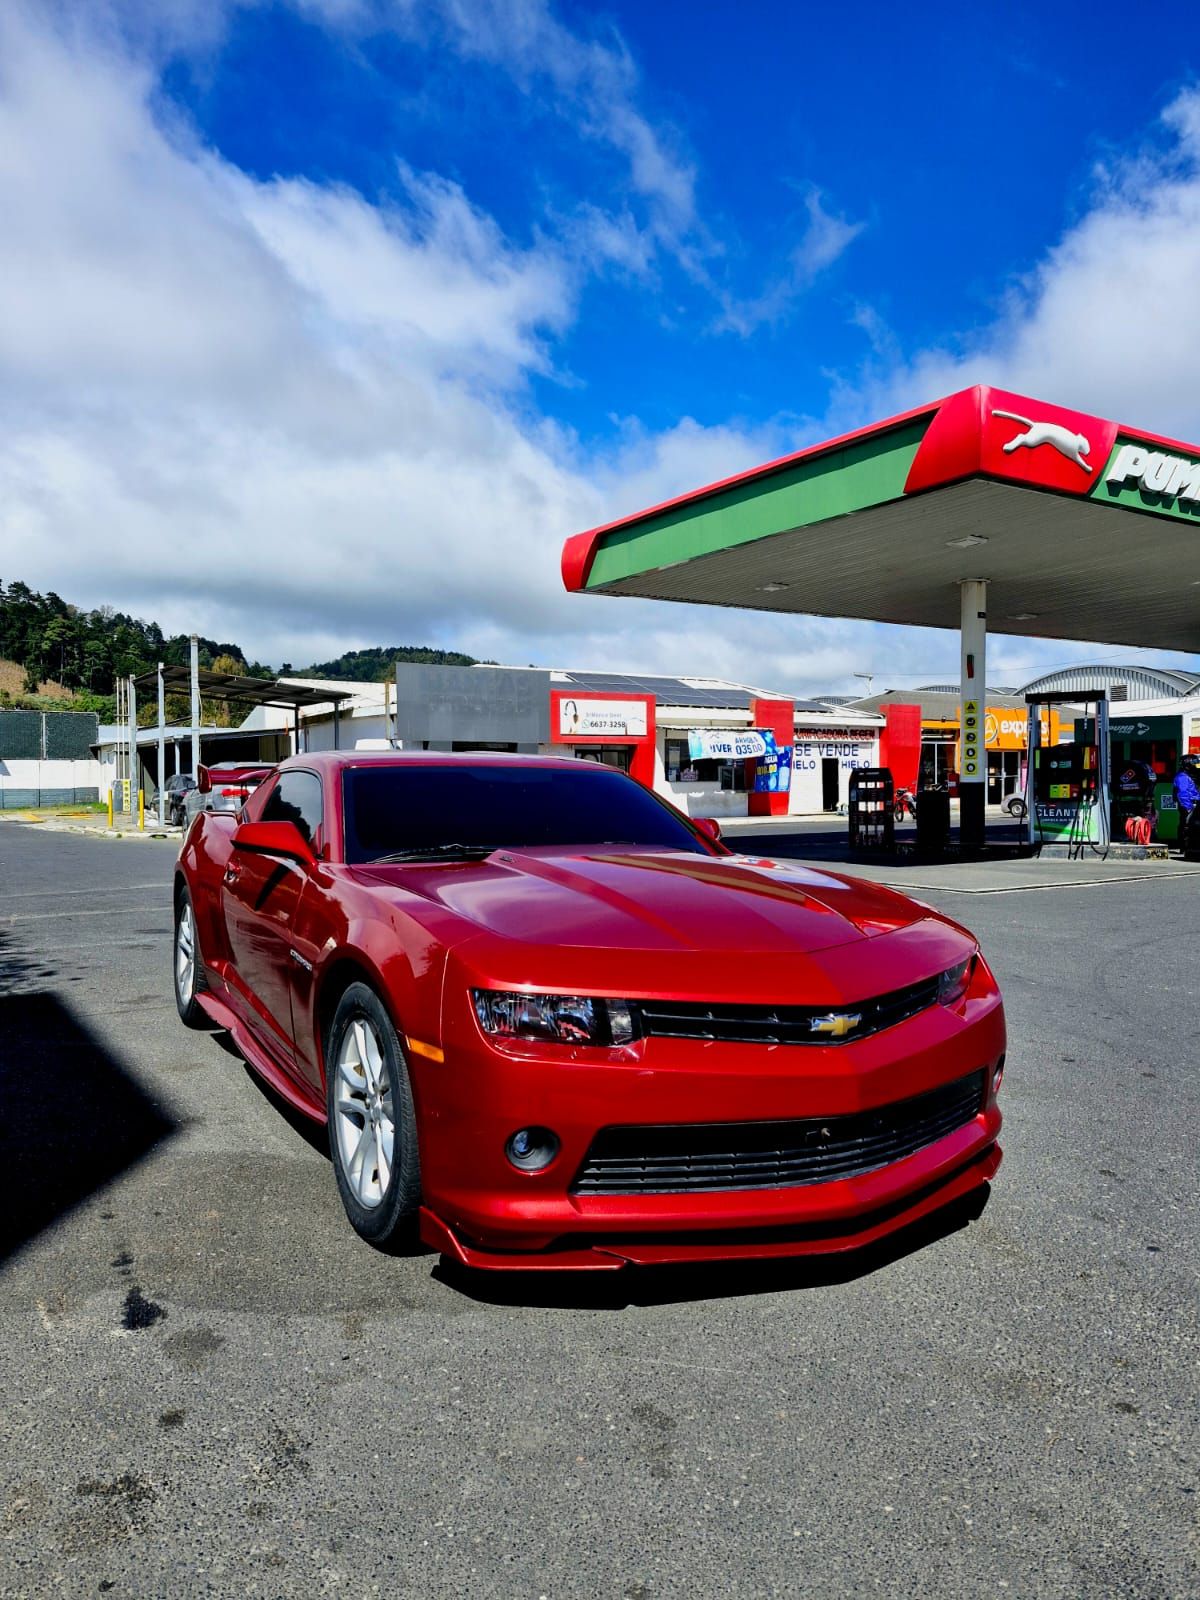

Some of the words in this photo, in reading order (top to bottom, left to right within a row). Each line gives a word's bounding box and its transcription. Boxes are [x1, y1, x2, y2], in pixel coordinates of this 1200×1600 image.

[1105, 444, 1200, 501] PUM
[795, 743, 811, 757] SE
[818, 743, 859, 757] VENDE
[792, 760, 816, 770] IELO
[841, 760, 870, 769] HIELO
